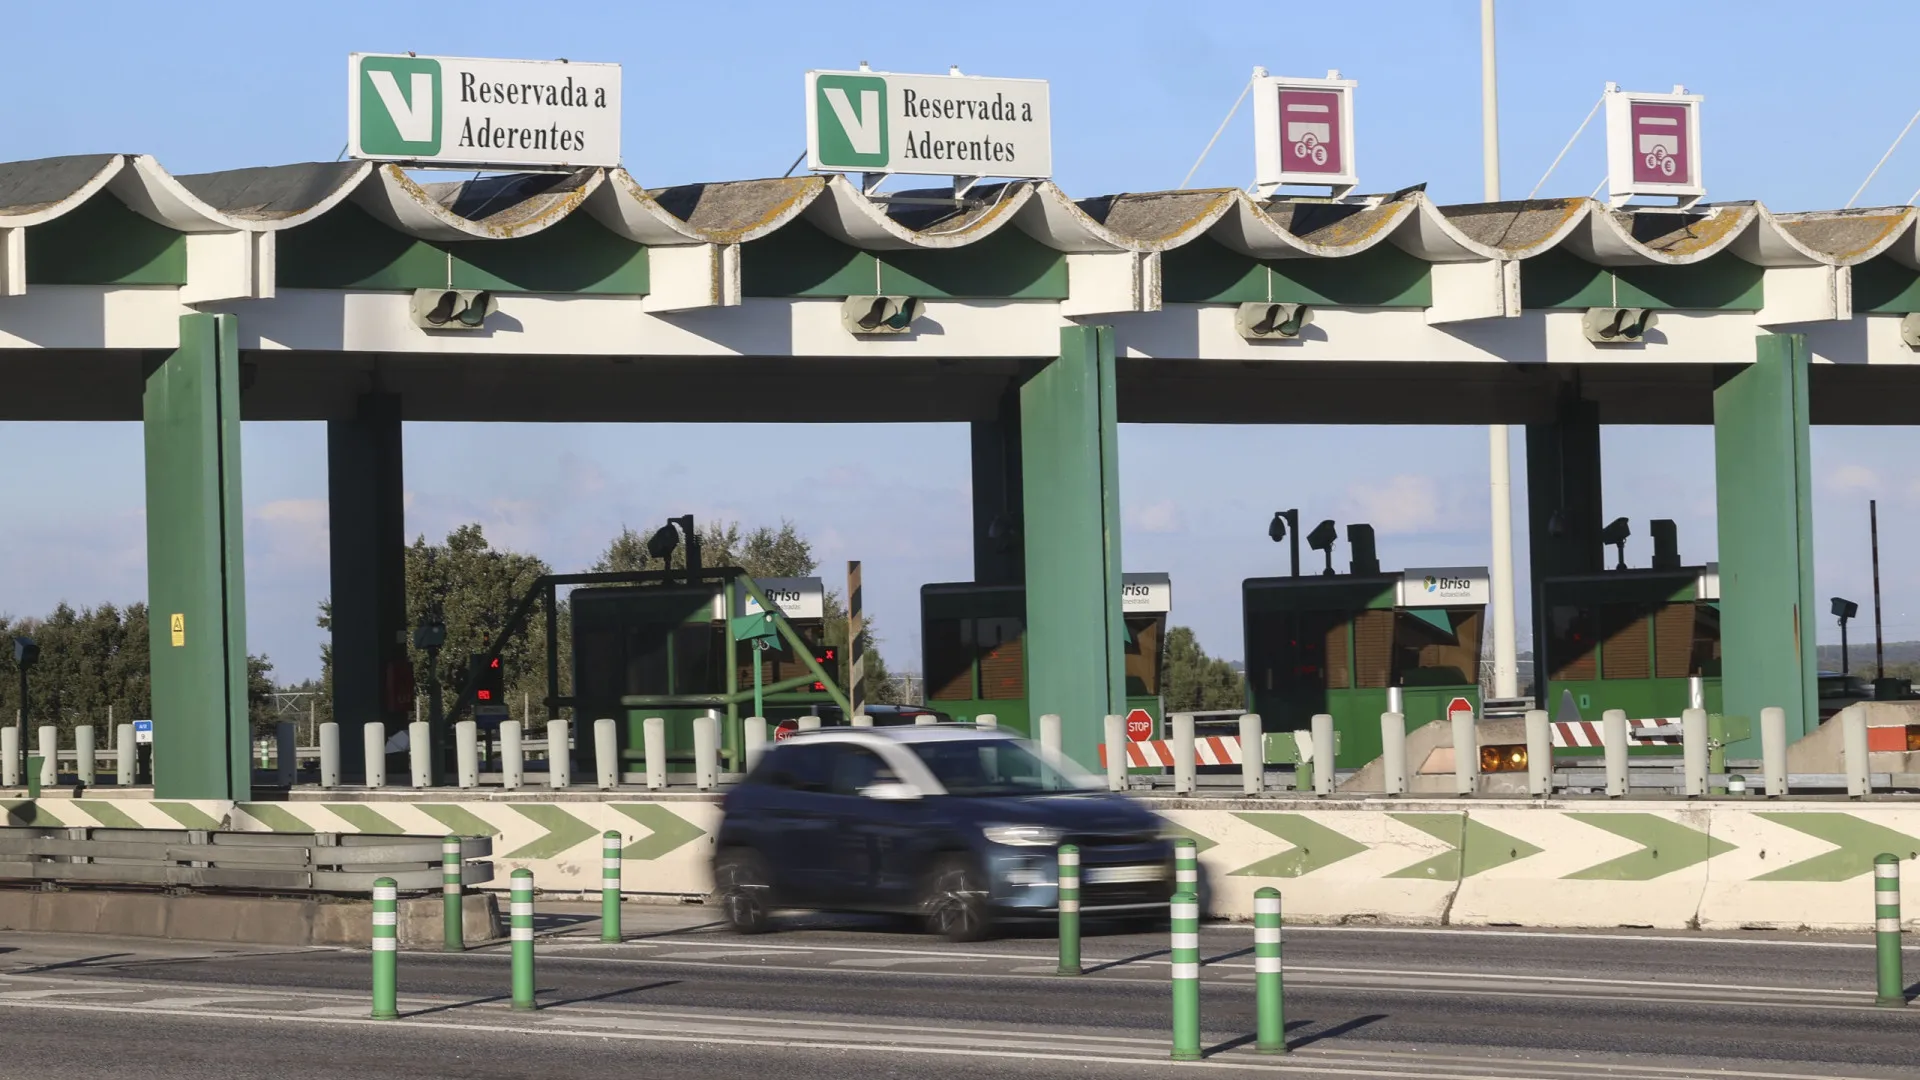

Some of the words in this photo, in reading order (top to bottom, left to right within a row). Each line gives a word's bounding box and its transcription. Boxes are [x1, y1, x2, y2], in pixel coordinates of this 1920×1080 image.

[459, 71, 588, 108] Reservada
[593, 86, 607, 109] a
[902, 88, 1016, 122] Reservada
[1021, 102, 1033, 123] a
[458, 116, 585, 152] Aderentes
[903, 130, 1016, 162] Aderentes
[765, 588, 800, 601] Brisa
[1440, 576, 1470, 589] Brisa
[1128, 721, 1150, 732] STOP
